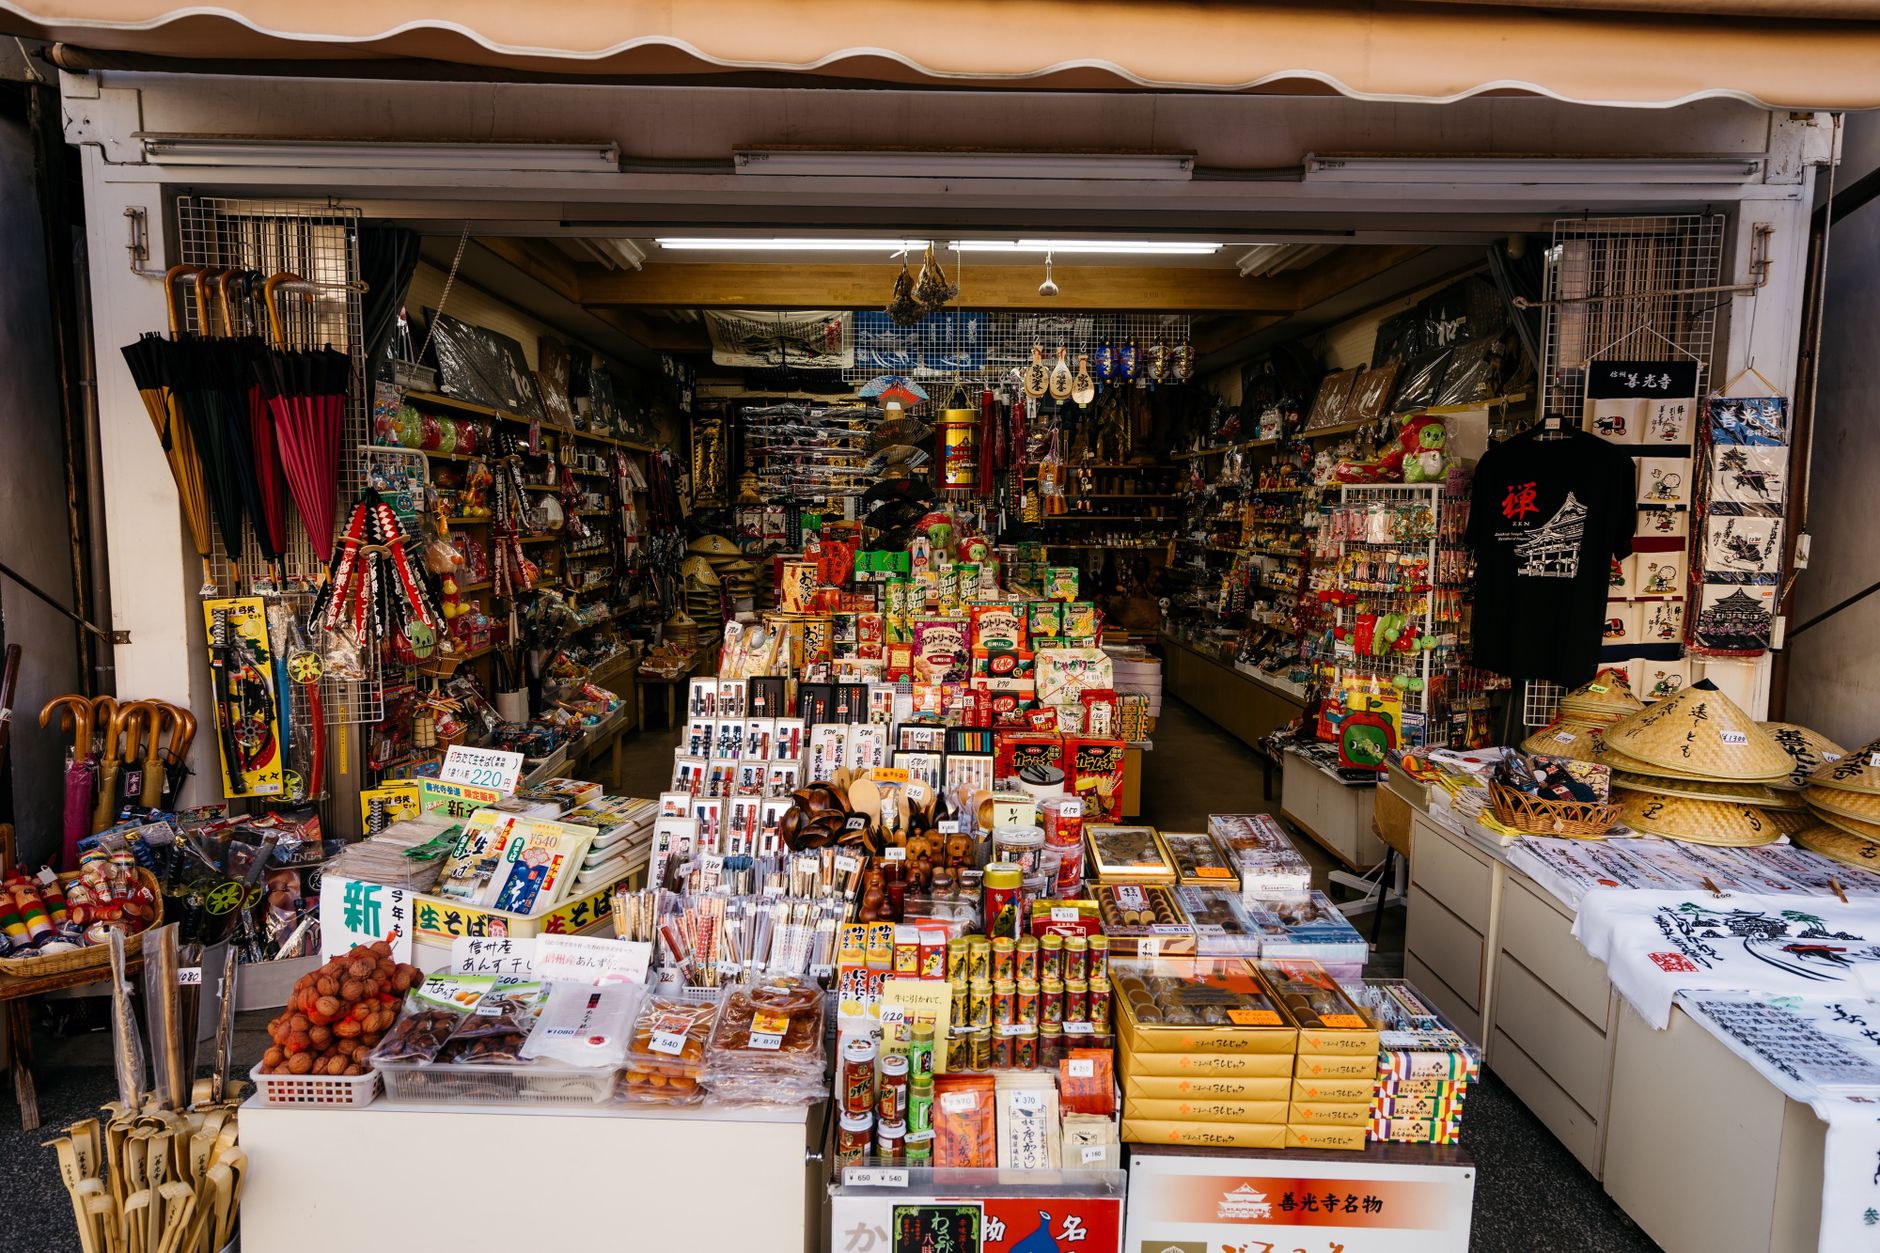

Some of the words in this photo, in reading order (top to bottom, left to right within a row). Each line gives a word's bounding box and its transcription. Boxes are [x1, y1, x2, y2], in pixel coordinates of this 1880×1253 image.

[1624, 373, 1672, 390] 善光寺
[1719, 405, 1784, 431] 善光寺
[978, 619, 1021, 632] カントリーマアム
[920, 635, 964, 647] カントリーマアム
[1053, 659, 1096, 671] じゃがりこ
[1721, 733, 1747, 743] ¥1300
[1075, 753, 1117, 771] カラムーチョ
[470, 768, 502, 788] 220
[503, 777, 512, 788] 円
[463, 788, 498, 803] 限定販売
[1063, 806, 1078, 815] 650
[343, 881, 383, 939] 新
[391, 889, 404, 938] 今年も
[545, 885, 613, 935] 生そば
[419, 903, 489, 937] 生そば
[852, 926, 866, 942] ゆず
[878, 925, 892, 940] ゆず
[468, 939, 512, 955] 信州産
[853, 969, 867, 1001] にんにく
[661, 1039, 679, 1049] 540
[1022, 1096, 1036, 1104] 370
[857, 1174, 871, 1182] 650
[888, 1174, 902, 1182] 540
[1277, 1192, 1384, 1214] 善光寺名物
[1056, 1214, 1088, 1243] 名
